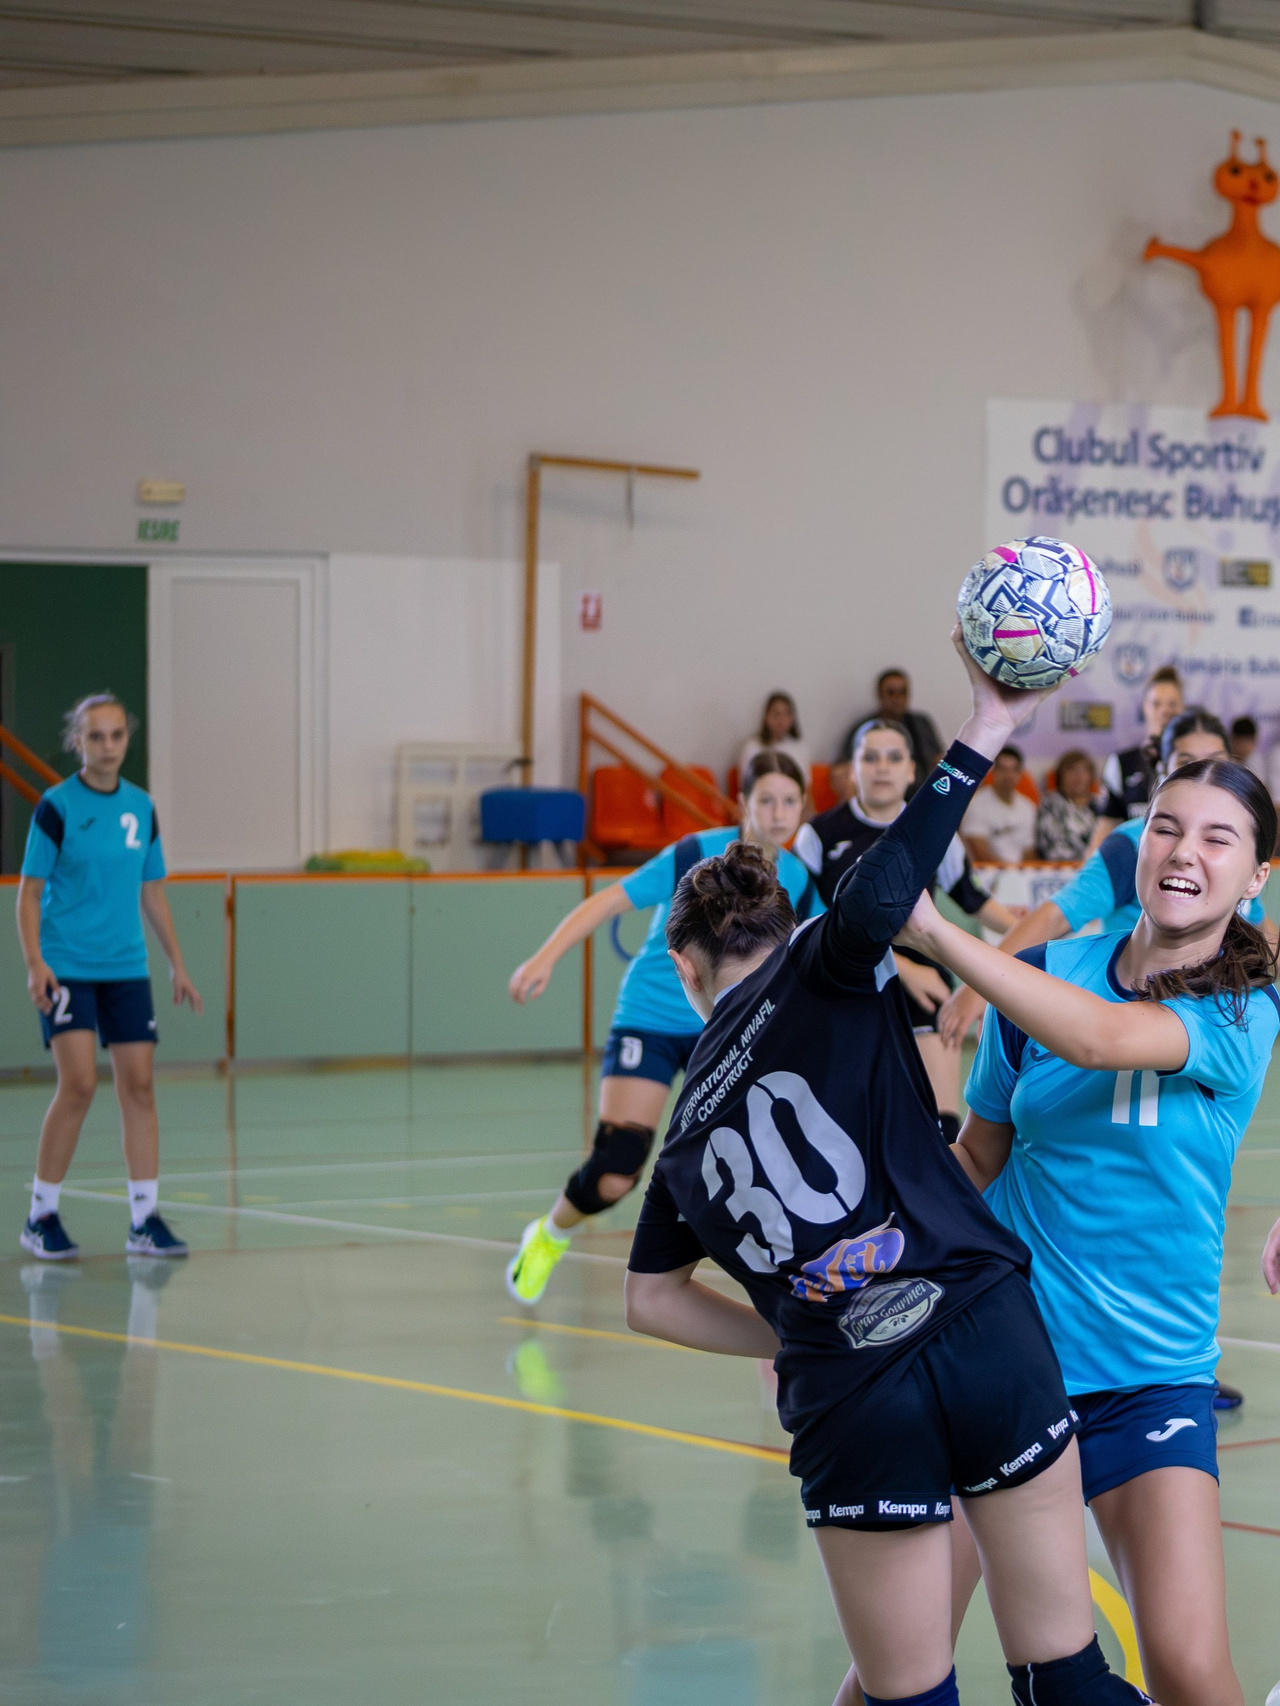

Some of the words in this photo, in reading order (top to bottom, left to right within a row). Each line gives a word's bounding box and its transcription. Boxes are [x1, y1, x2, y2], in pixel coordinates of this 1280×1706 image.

[1034, 426, 1138, 466] Clubul
[1147, 431, 1265, 477] Sportiv
[1002, 475, 1173, 526] Orășenesc
[120, 812, 141, 849] 2
[52, 986, 73, 1026] 2
[680, 1044, 741, 1134] INTERNATIONAL
[740, 998, 776, 1049] NIVAFIL
[697, 1046, 754, 1123] CONSTRUCT
[701, 1071, 867, 1274] 30
[880, 1281, 928, 1319] Gourmet
[999, 1442, 1044, 1477] Kempa
[806, 1509, 821, 1523] empa
[829, 1503, 865, 1519] Kempa
[878, 1499, 928, 1518] Kempa
